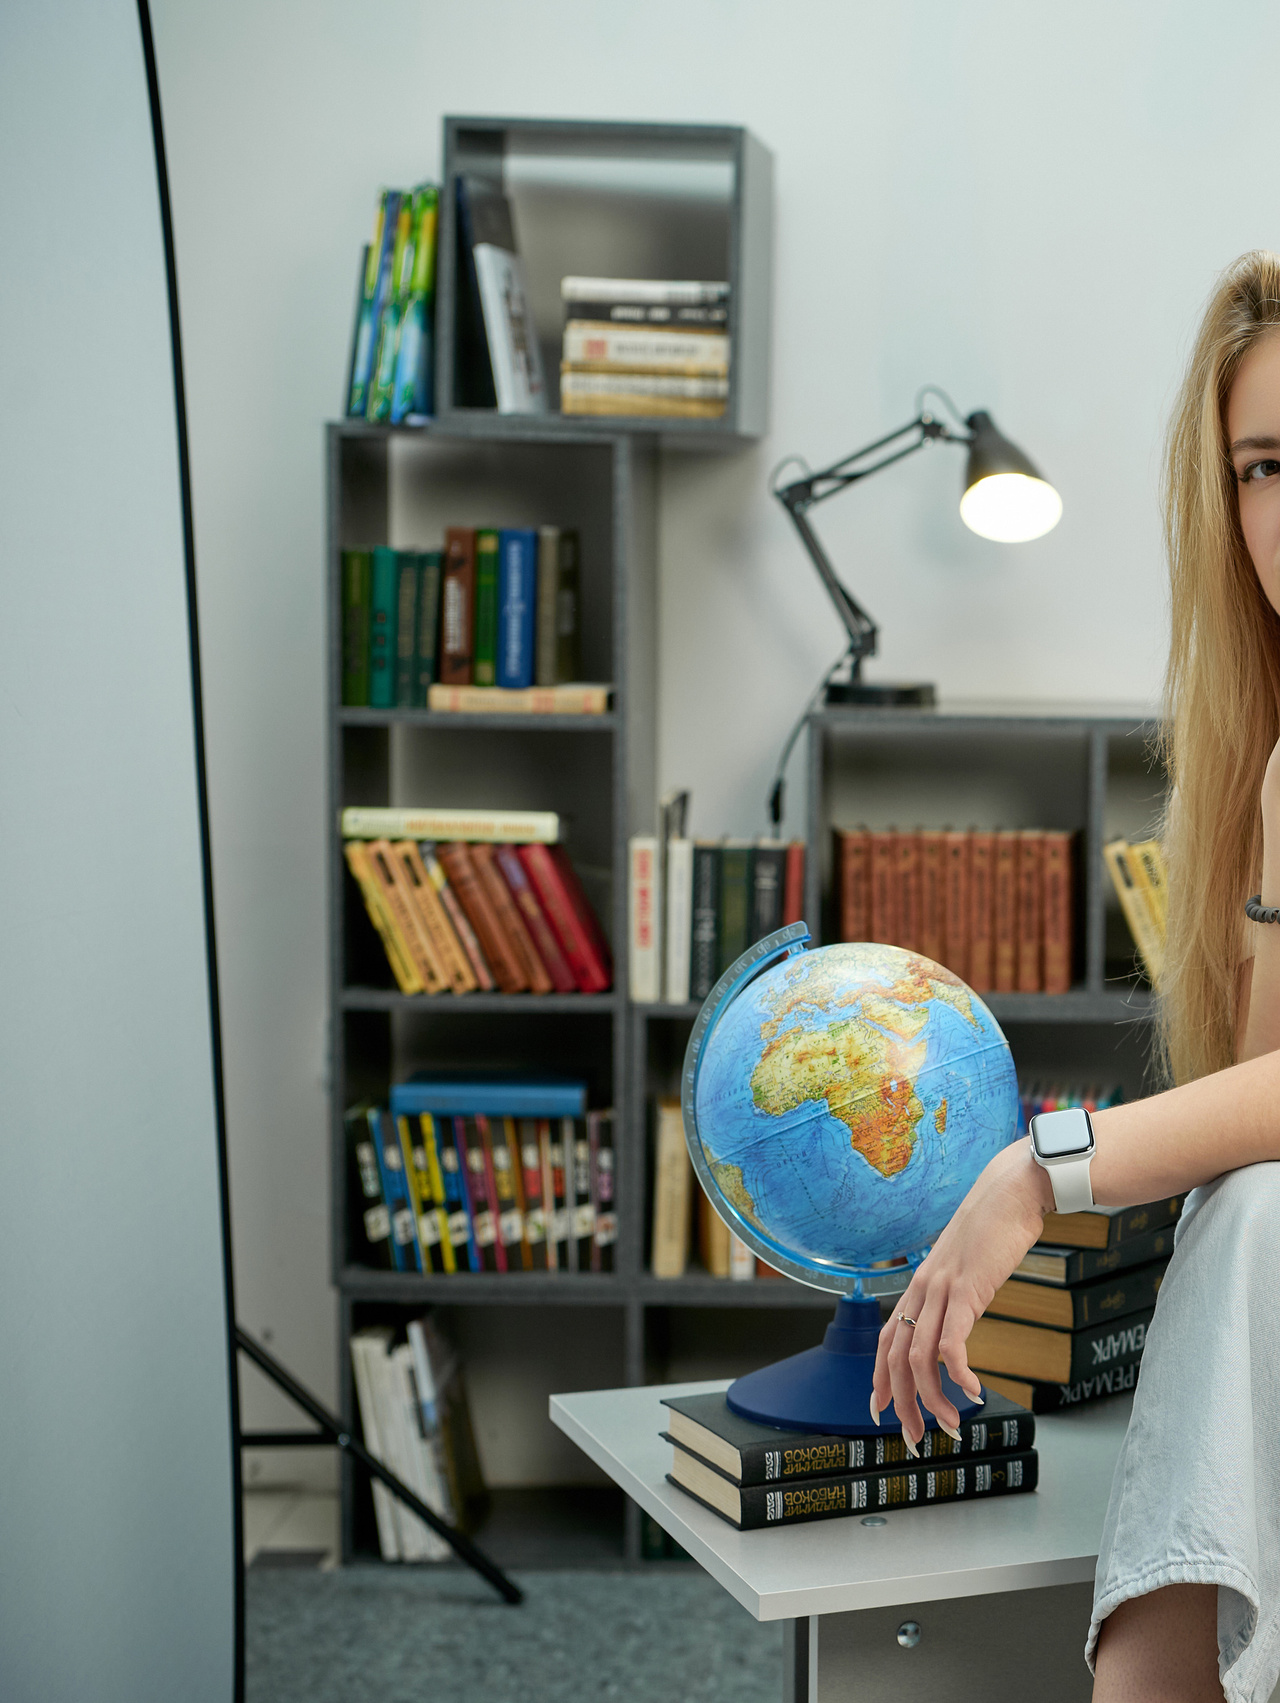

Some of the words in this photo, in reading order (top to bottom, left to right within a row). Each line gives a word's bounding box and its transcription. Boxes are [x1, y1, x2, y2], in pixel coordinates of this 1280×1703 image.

[784, 1443, 846, 1464] НАБОКОВ
[783, 1456, 846, 1475] ВЛАДИМИР
[992, 1470, 1005, 1482] 3
[784, 1485, 846, 1506] НАБОКОВ
[784, 1498, 847, 1517] ВЛАДИМИР
